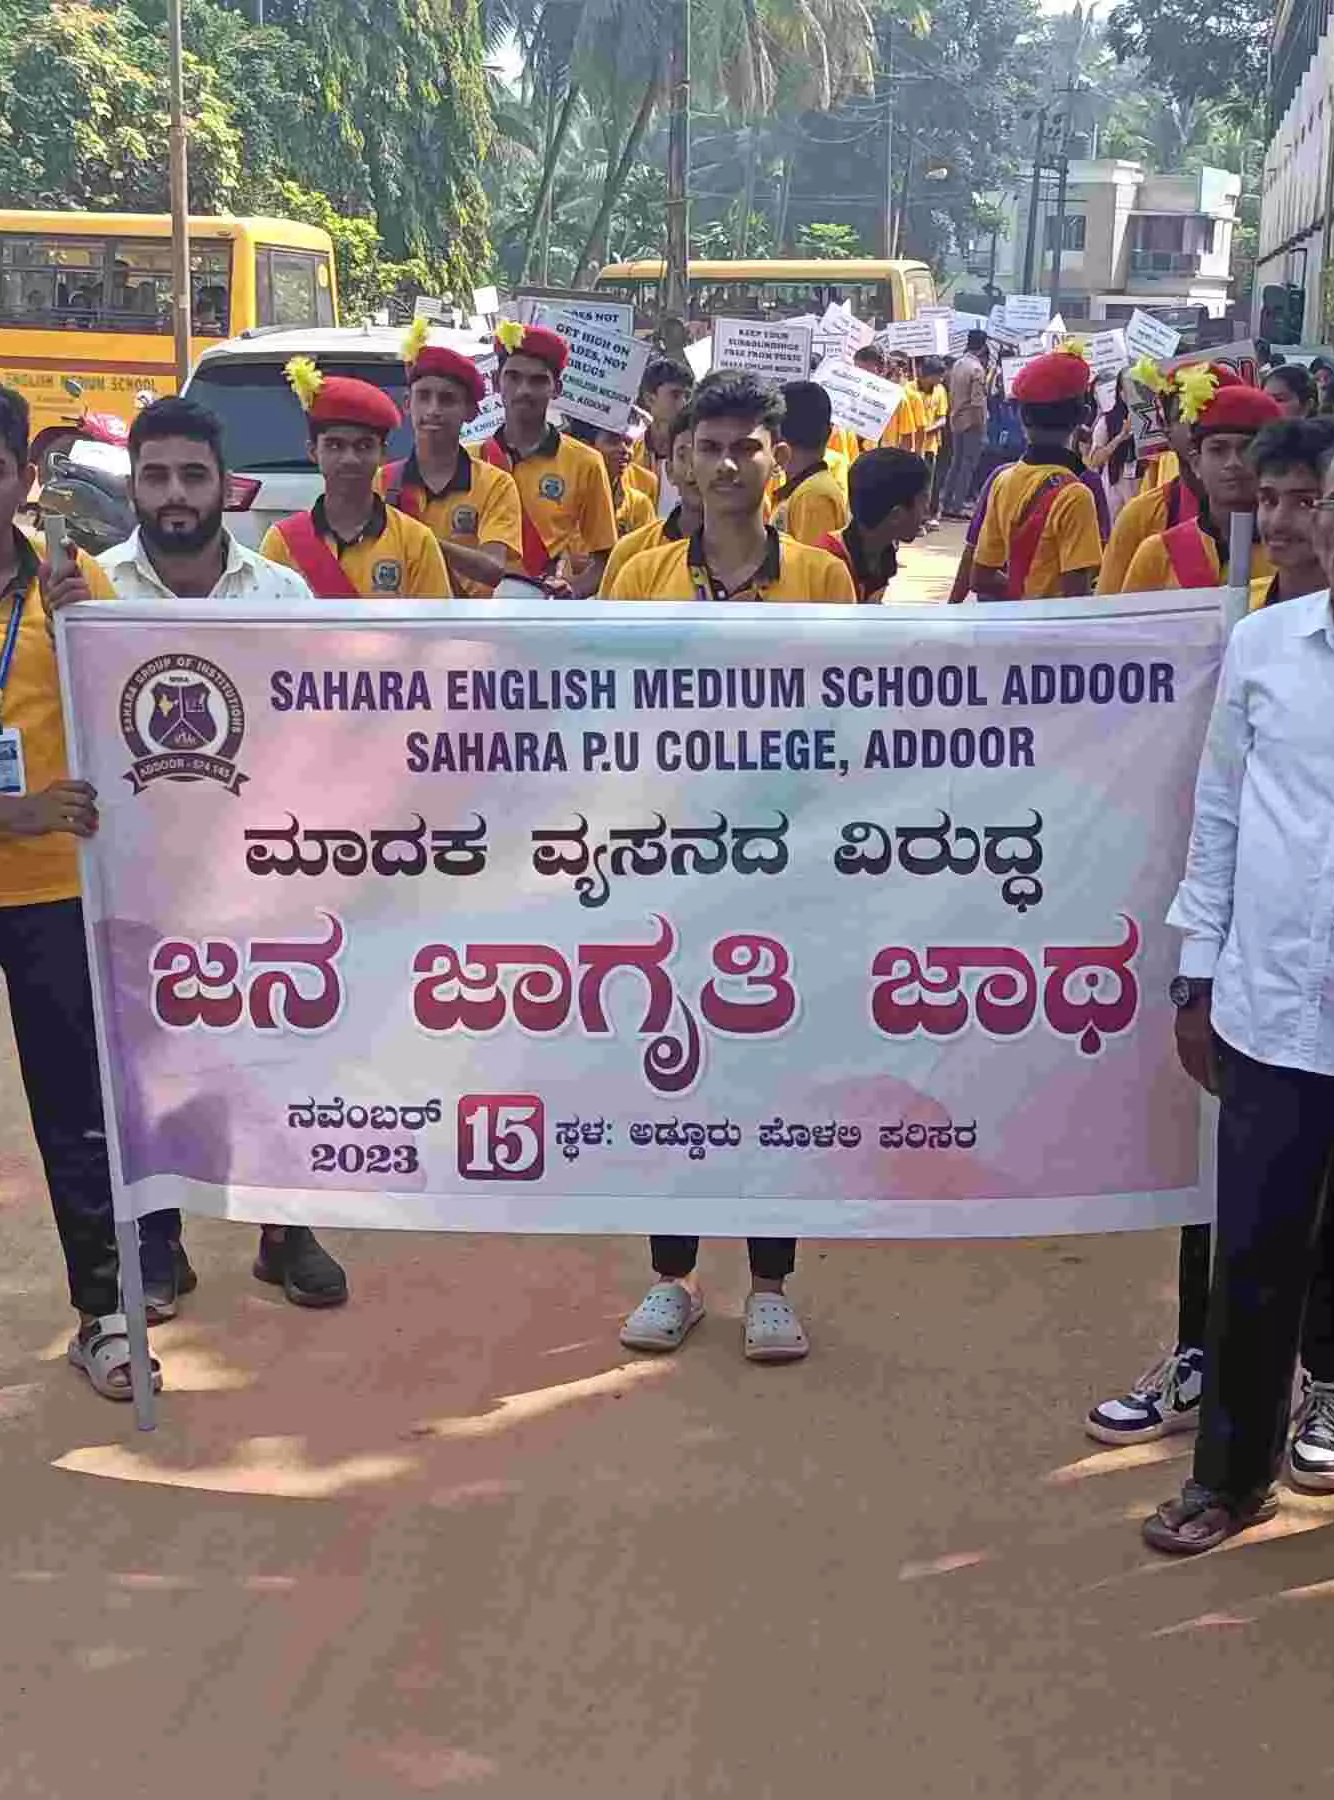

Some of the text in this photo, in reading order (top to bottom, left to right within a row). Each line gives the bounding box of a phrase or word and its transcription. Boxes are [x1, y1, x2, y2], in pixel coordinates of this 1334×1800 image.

[270, 662, 1175, 713] SAHARA ENGLISH MEDIUM SCHOOL ADDOOR
[407, 727, 1036, 777] SAHARA P.U COLLEGE, ADDOOR
[244, 808, 1044, 914] ಮಾದಕ ವ್ಯಸನದ ವಿರುದ್ಧ
[151, 911, 1140, 1092] ಜನ ಜಾಗೃತಿ ಜಾಥ
[288, 1096, 443, 1130] ನವೆಂಬರ್
[465, 1104, 540, 1172] 15
[555, 1114, 614, 1162] ಸ್ಥಳ:
[630, 1115, 742, 1161] ಅಡ್ಡೂರು
[878, 1118, 978, 1150] ಪರಿಸರ
[310, 1143, 420, 1174] 2023
